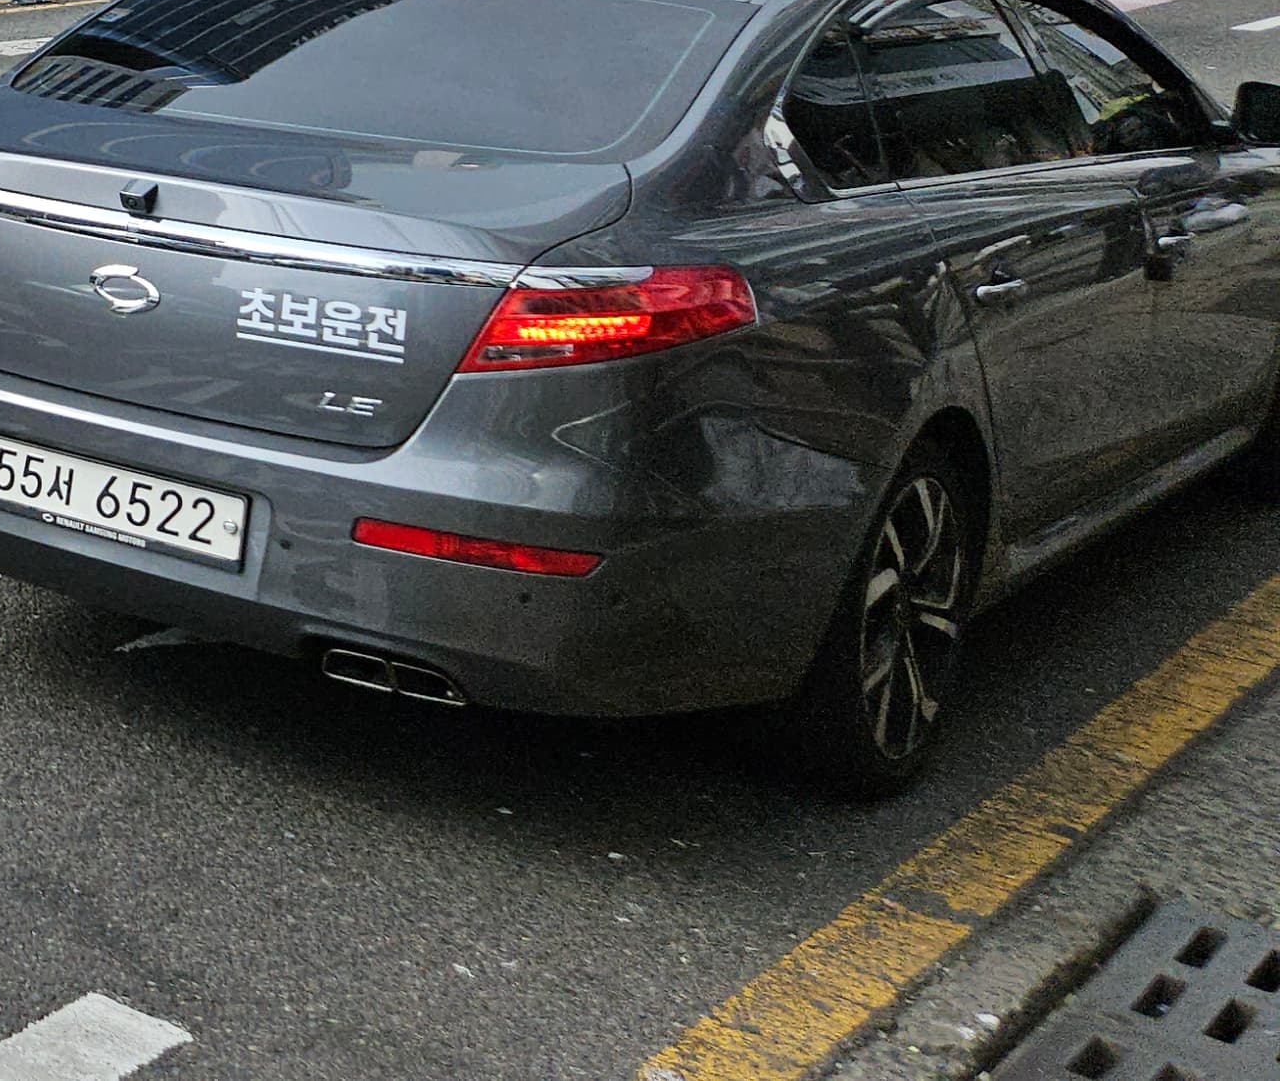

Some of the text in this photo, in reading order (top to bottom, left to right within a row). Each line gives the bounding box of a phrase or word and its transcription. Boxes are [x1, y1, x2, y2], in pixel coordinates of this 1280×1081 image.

[236, 285, 409, 352] 초보운전
[317, 390, 385, 419] LE
[55, 516, 147, 549] RENAULT SAMSUNG MOTORS
[95, 472, 217, 547] 6522
